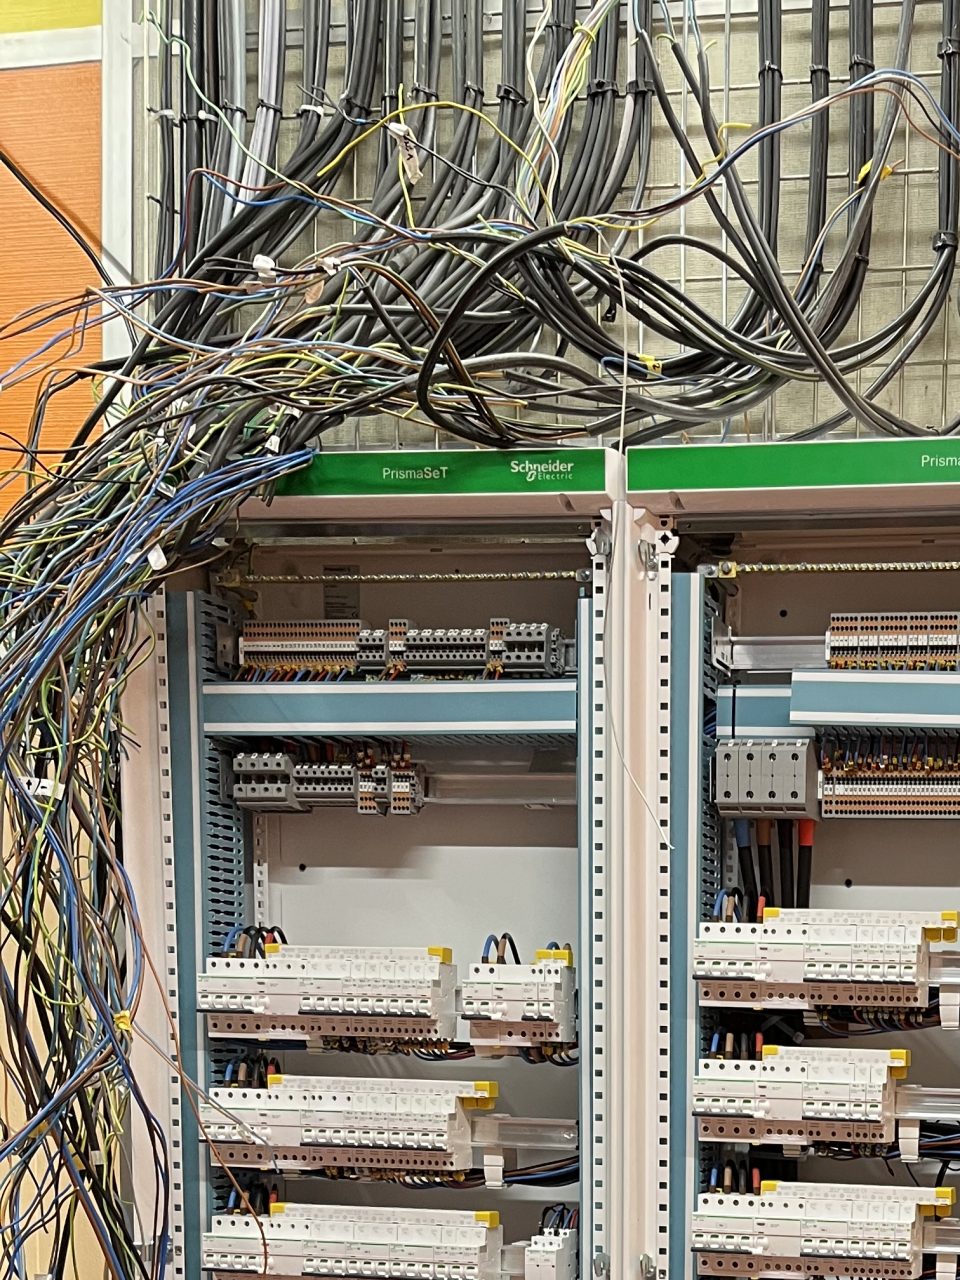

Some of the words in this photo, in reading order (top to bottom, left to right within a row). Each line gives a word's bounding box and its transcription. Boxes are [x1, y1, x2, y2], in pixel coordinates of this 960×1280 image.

[382, 466, 449, 479] PrismaSeT
[510, 460, 574, 473] Schneider
[537, 472, 573, 480] Electric
